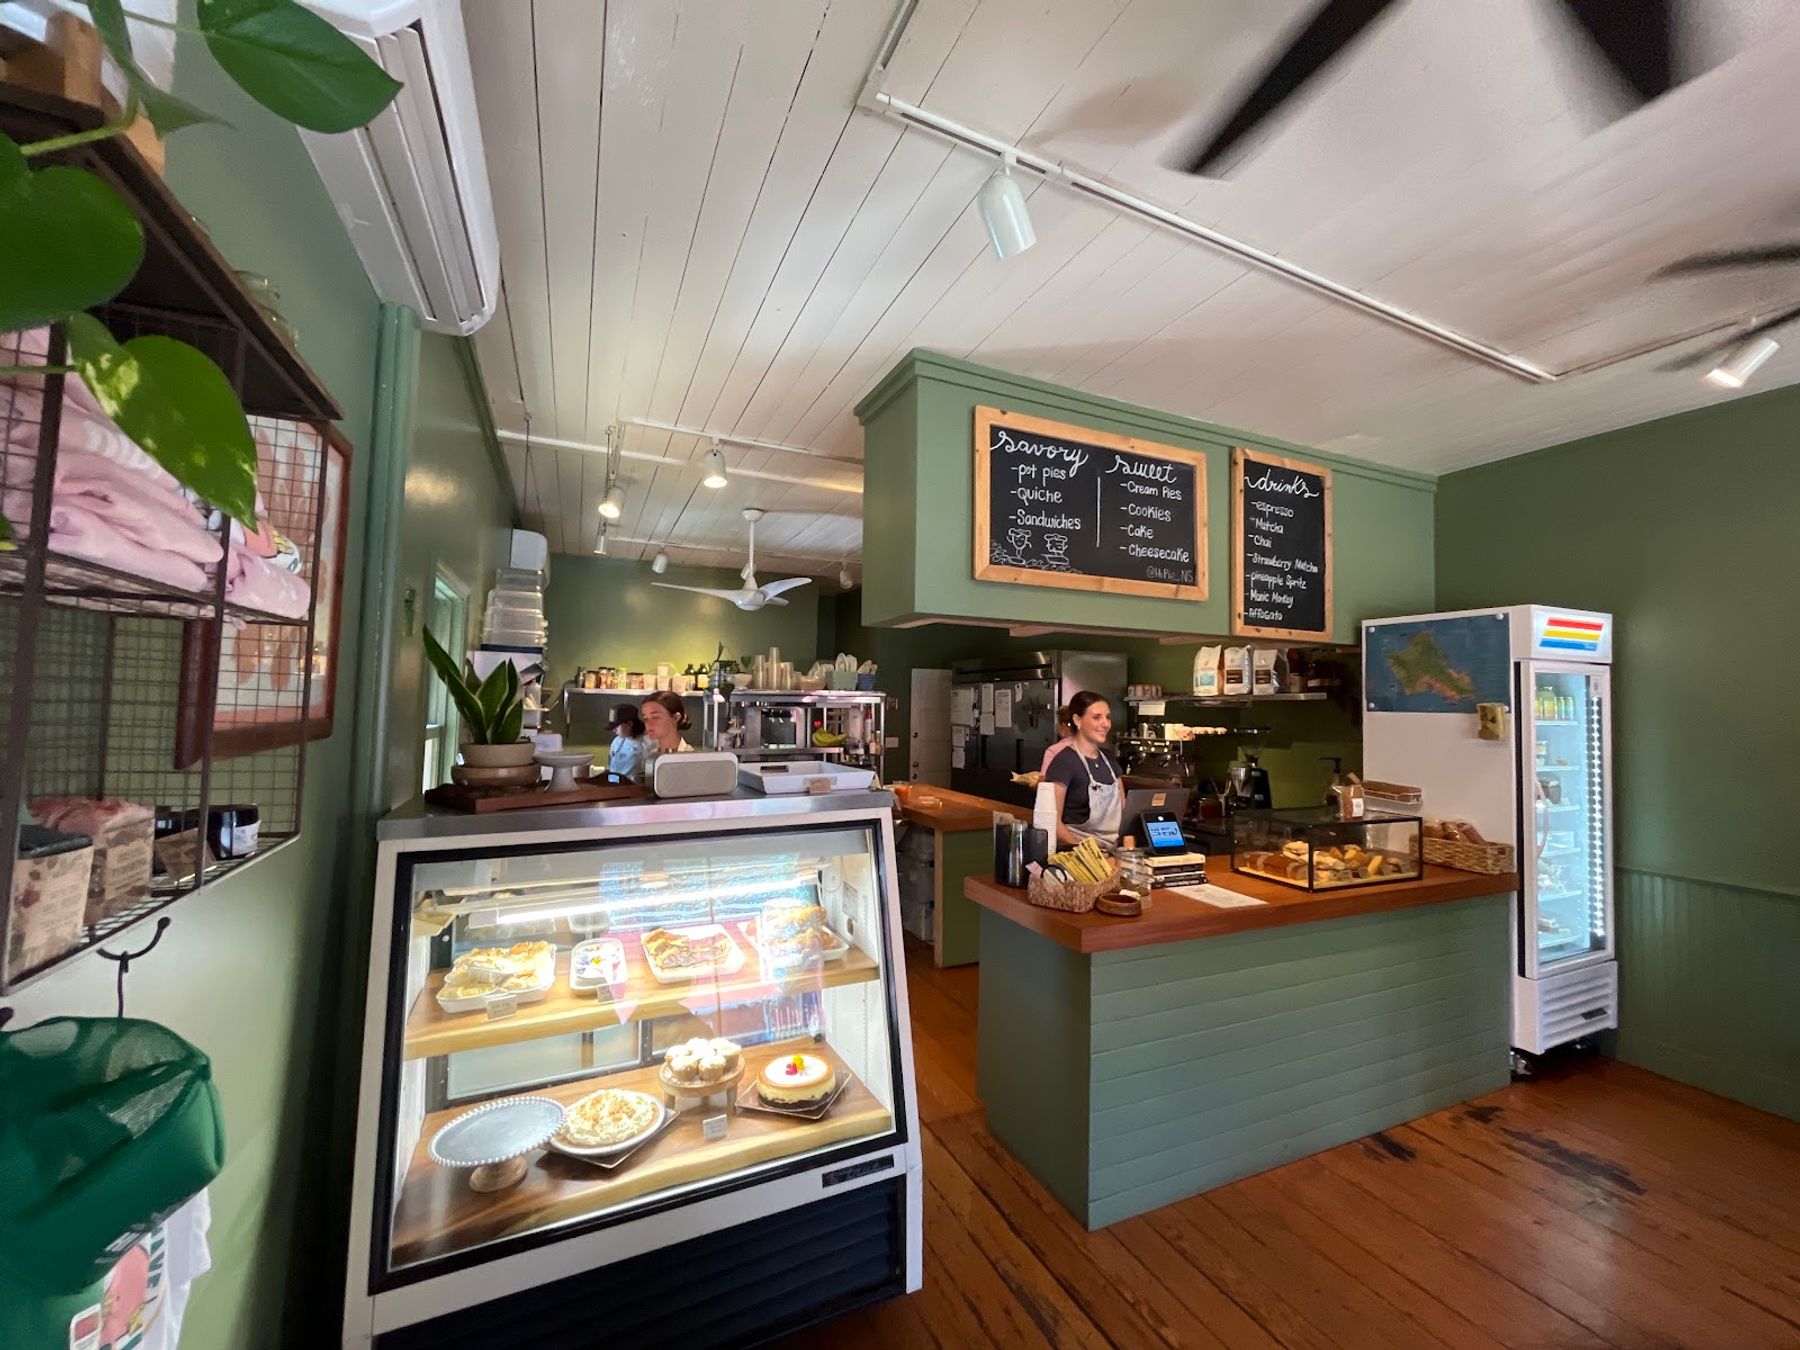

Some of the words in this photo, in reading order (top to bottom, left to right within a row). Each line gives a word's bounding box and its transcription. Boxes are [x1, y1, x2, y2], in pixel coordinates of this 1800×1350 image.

[990, 430, 1089, 478] savory
[1042, 466, 1067, 488] pies
[1104, 454, 1177, 484] sweet
[1162, 485, 1183, 501] Pies
